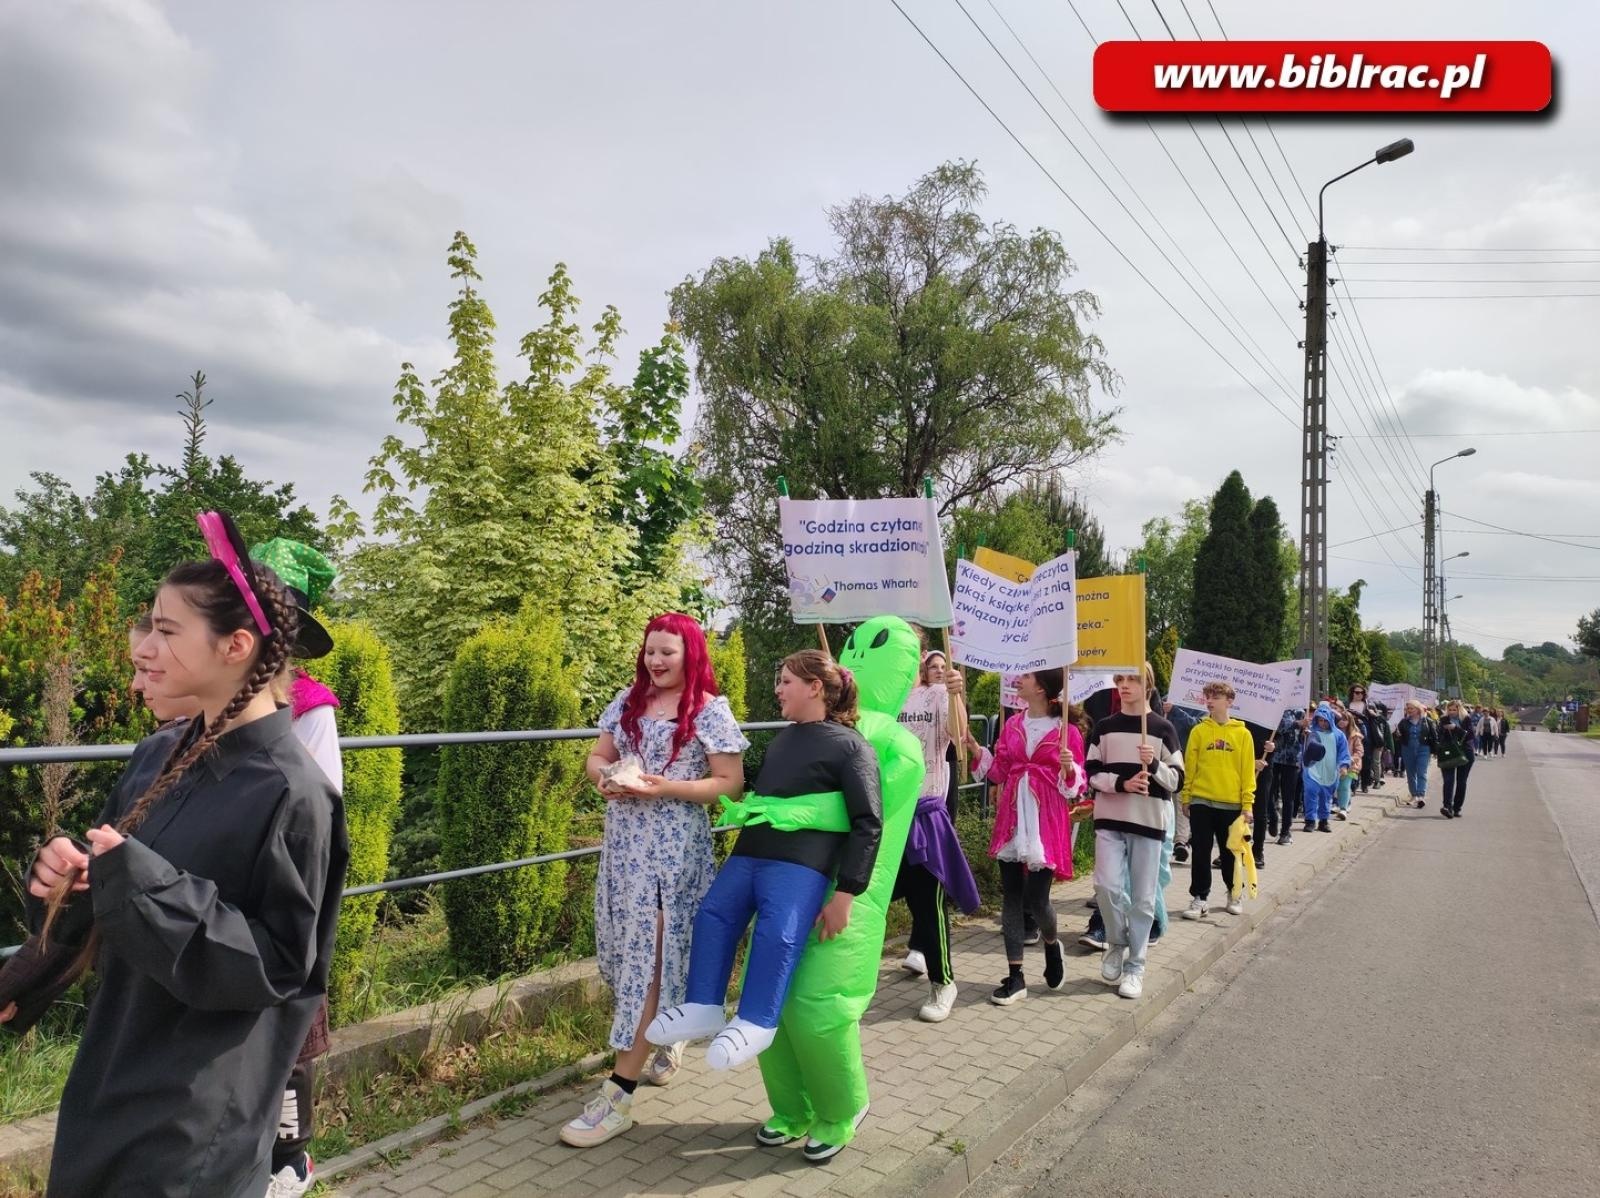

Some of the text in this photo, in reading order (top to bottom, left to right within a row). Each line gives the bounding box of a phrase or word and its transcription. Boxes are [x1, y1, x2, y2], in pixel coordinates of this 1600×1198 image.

[799, 519, 865, 535] "Godzina
[784, 540, 845, 557] godziną
[834, 577, 919, 592] Thomas Wharto
[956, 582, 986, 602] akąś
[1051, 579, 1071, 593] nią
[1033, 601, 1065, 617] ońca
